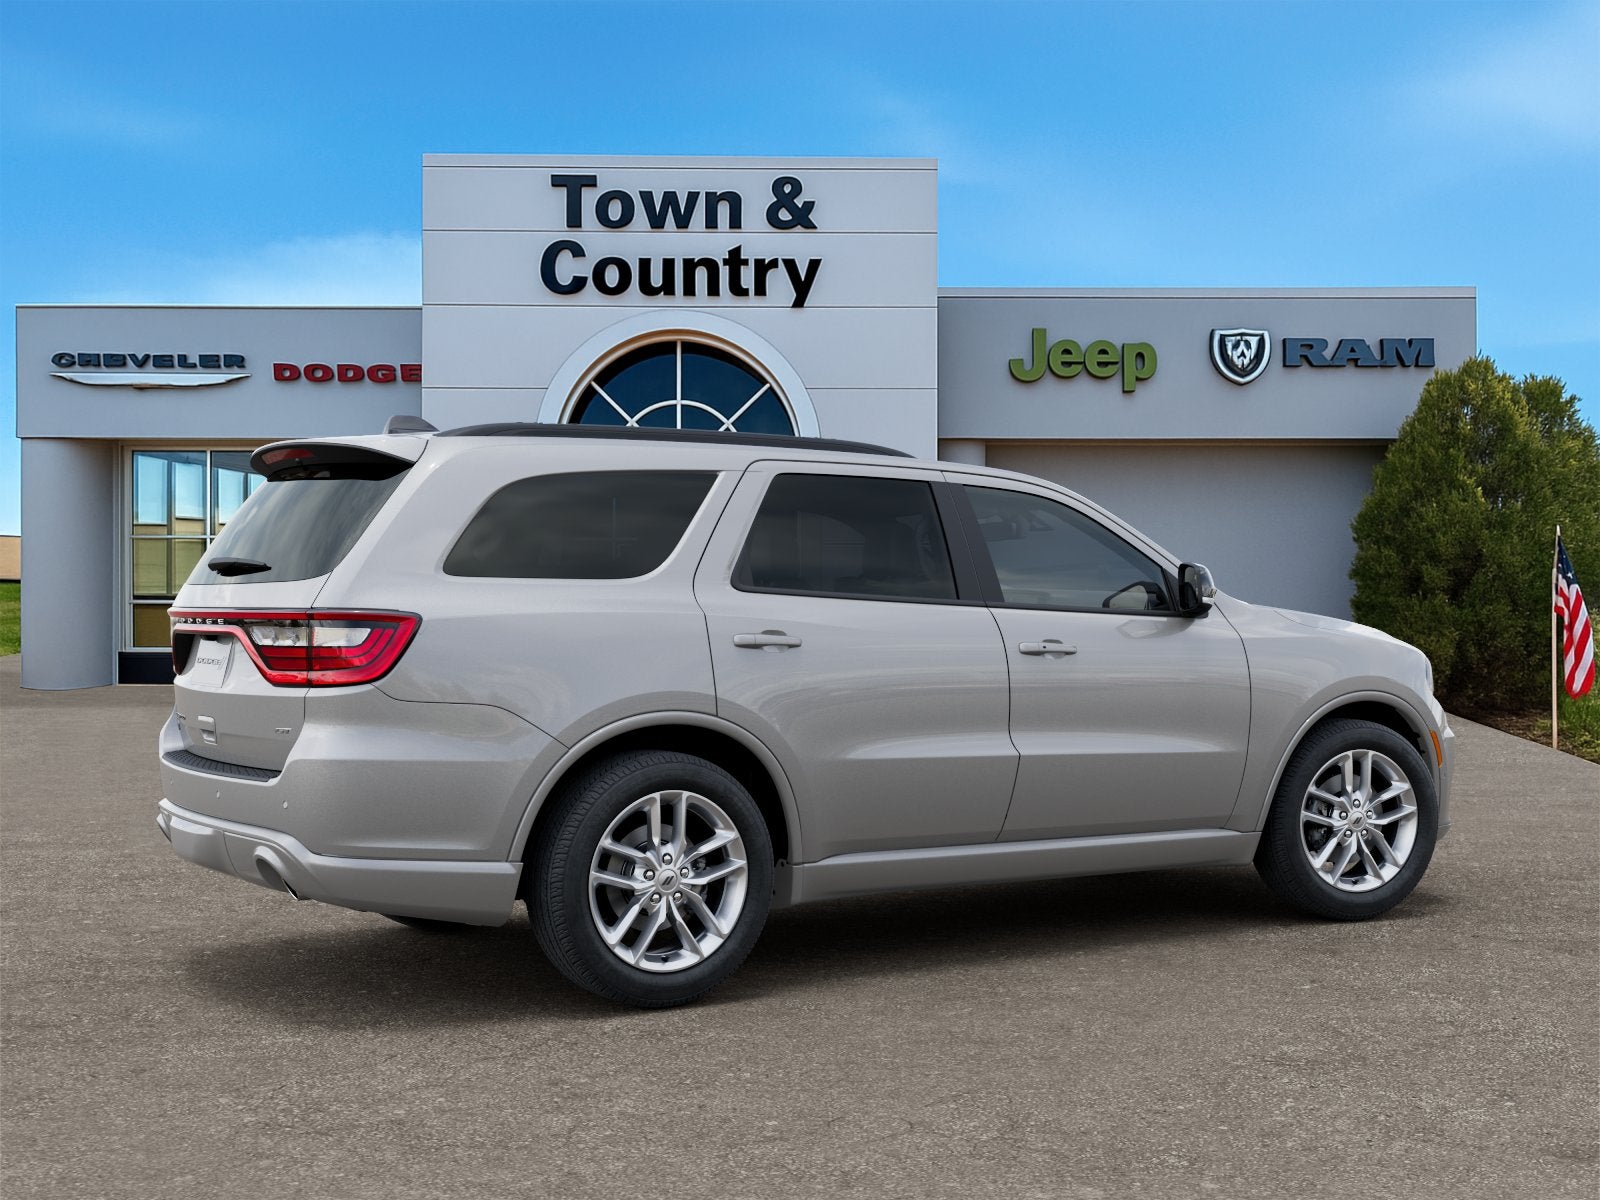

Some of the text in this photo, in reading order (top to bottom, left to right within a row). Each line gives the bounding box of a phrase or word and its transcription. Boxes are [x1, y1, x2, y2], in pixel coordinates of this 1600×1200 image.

[550, 174, 818, 230] Town &
[540, 239, 823, 308] Country
[273, 363, 422, 383] DODGE
[1009, 328, 1157, 392] Jeep
[1282, 338, 1435, 368] RAM
